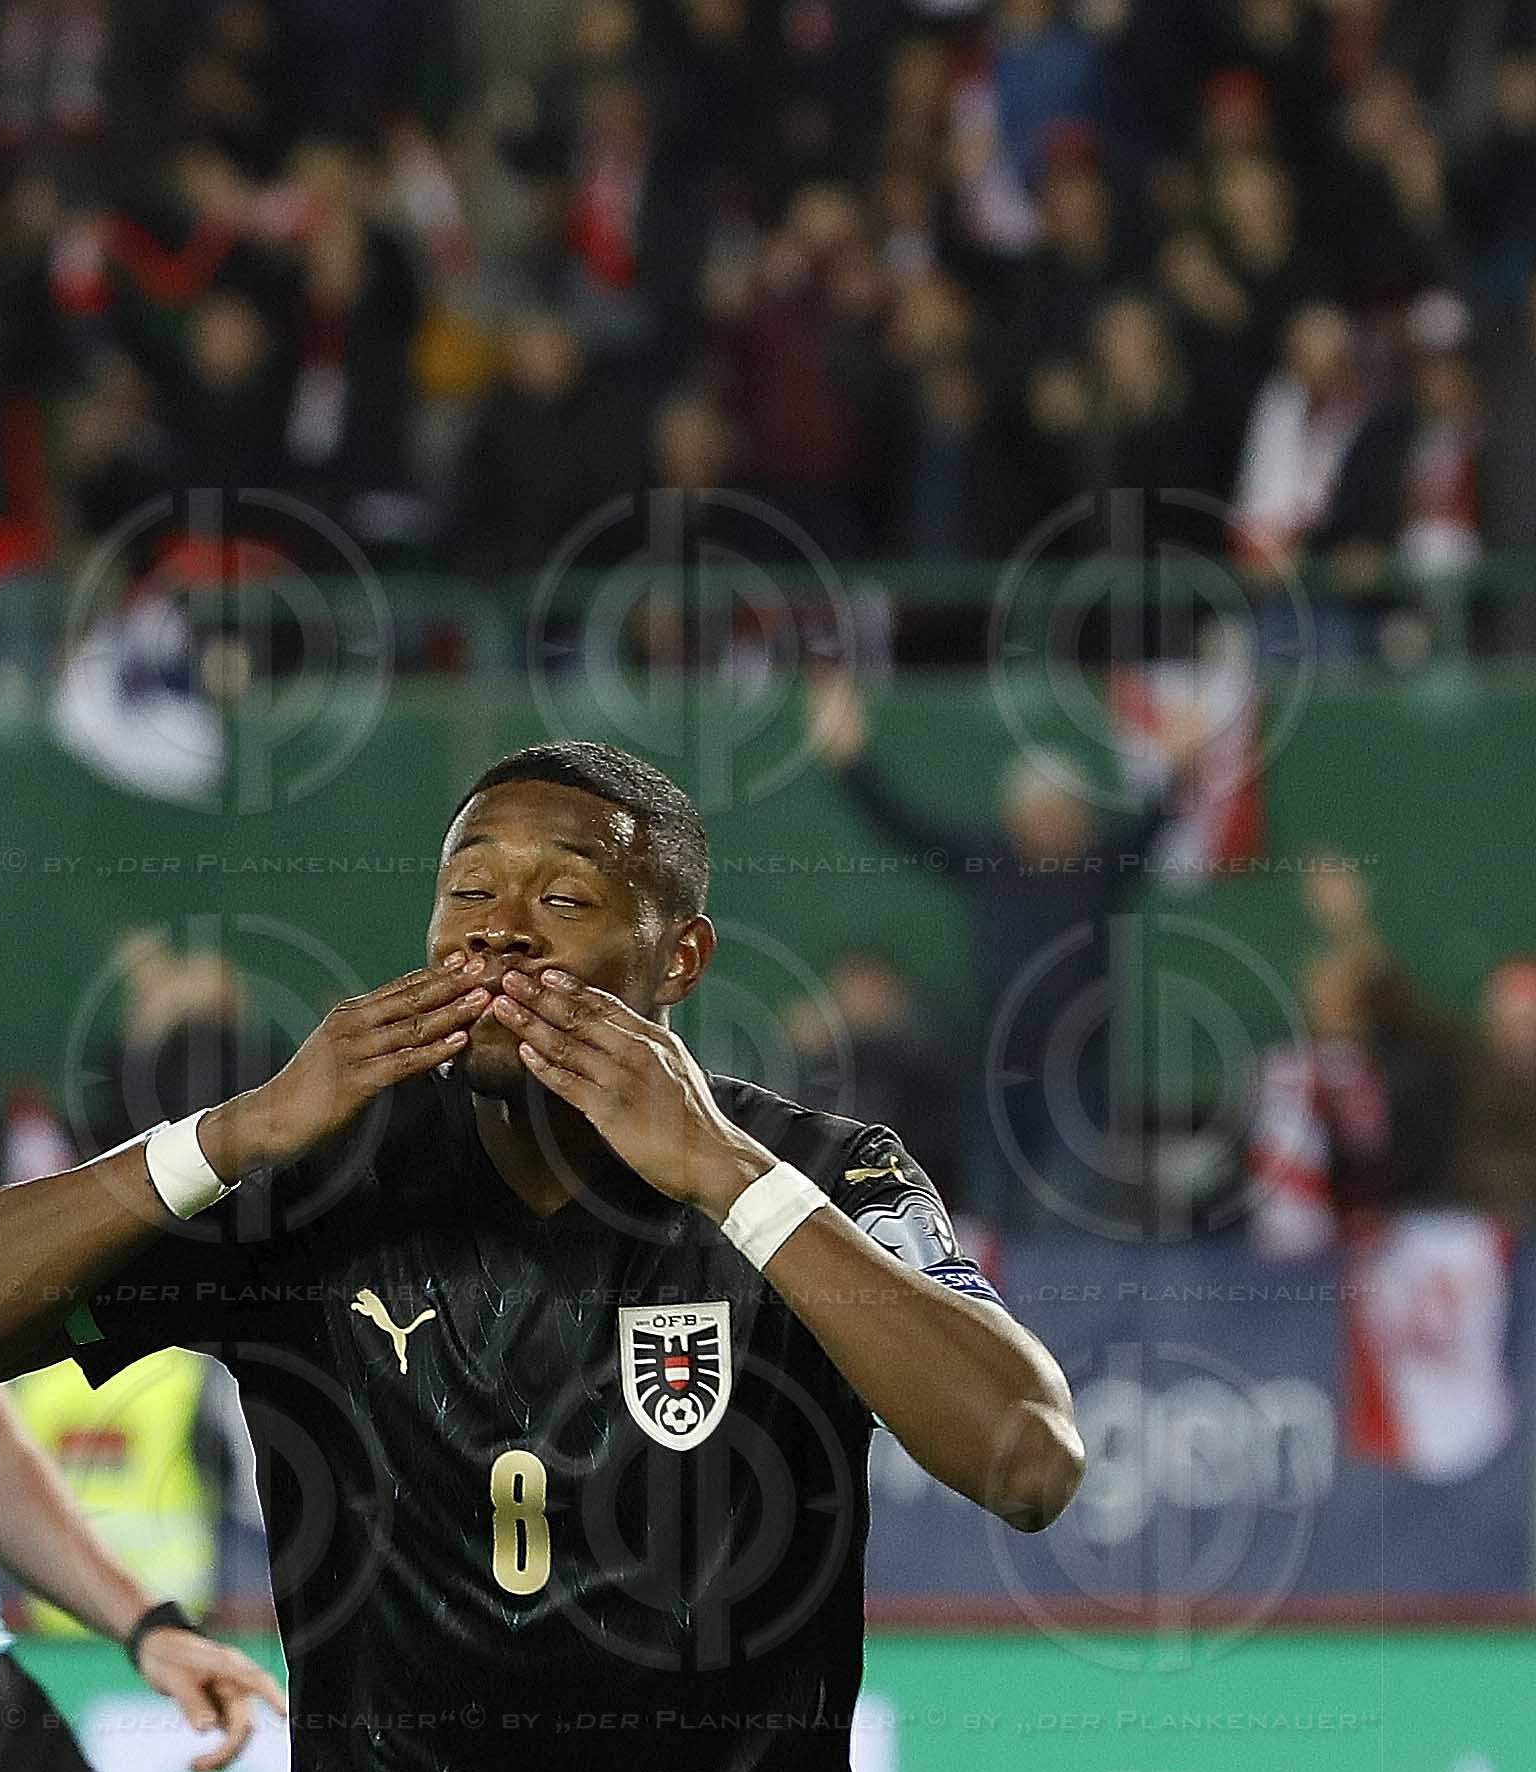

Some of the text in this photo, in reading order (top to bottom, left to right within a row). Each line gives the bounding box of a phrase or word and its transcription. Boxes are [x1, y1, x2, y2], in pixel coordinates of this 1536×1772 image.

[932, 1272, 991, 1290] ESPE
[652, 1314, 697, 1328] ÖFB
[490, 1449, 552, 1596] 8
